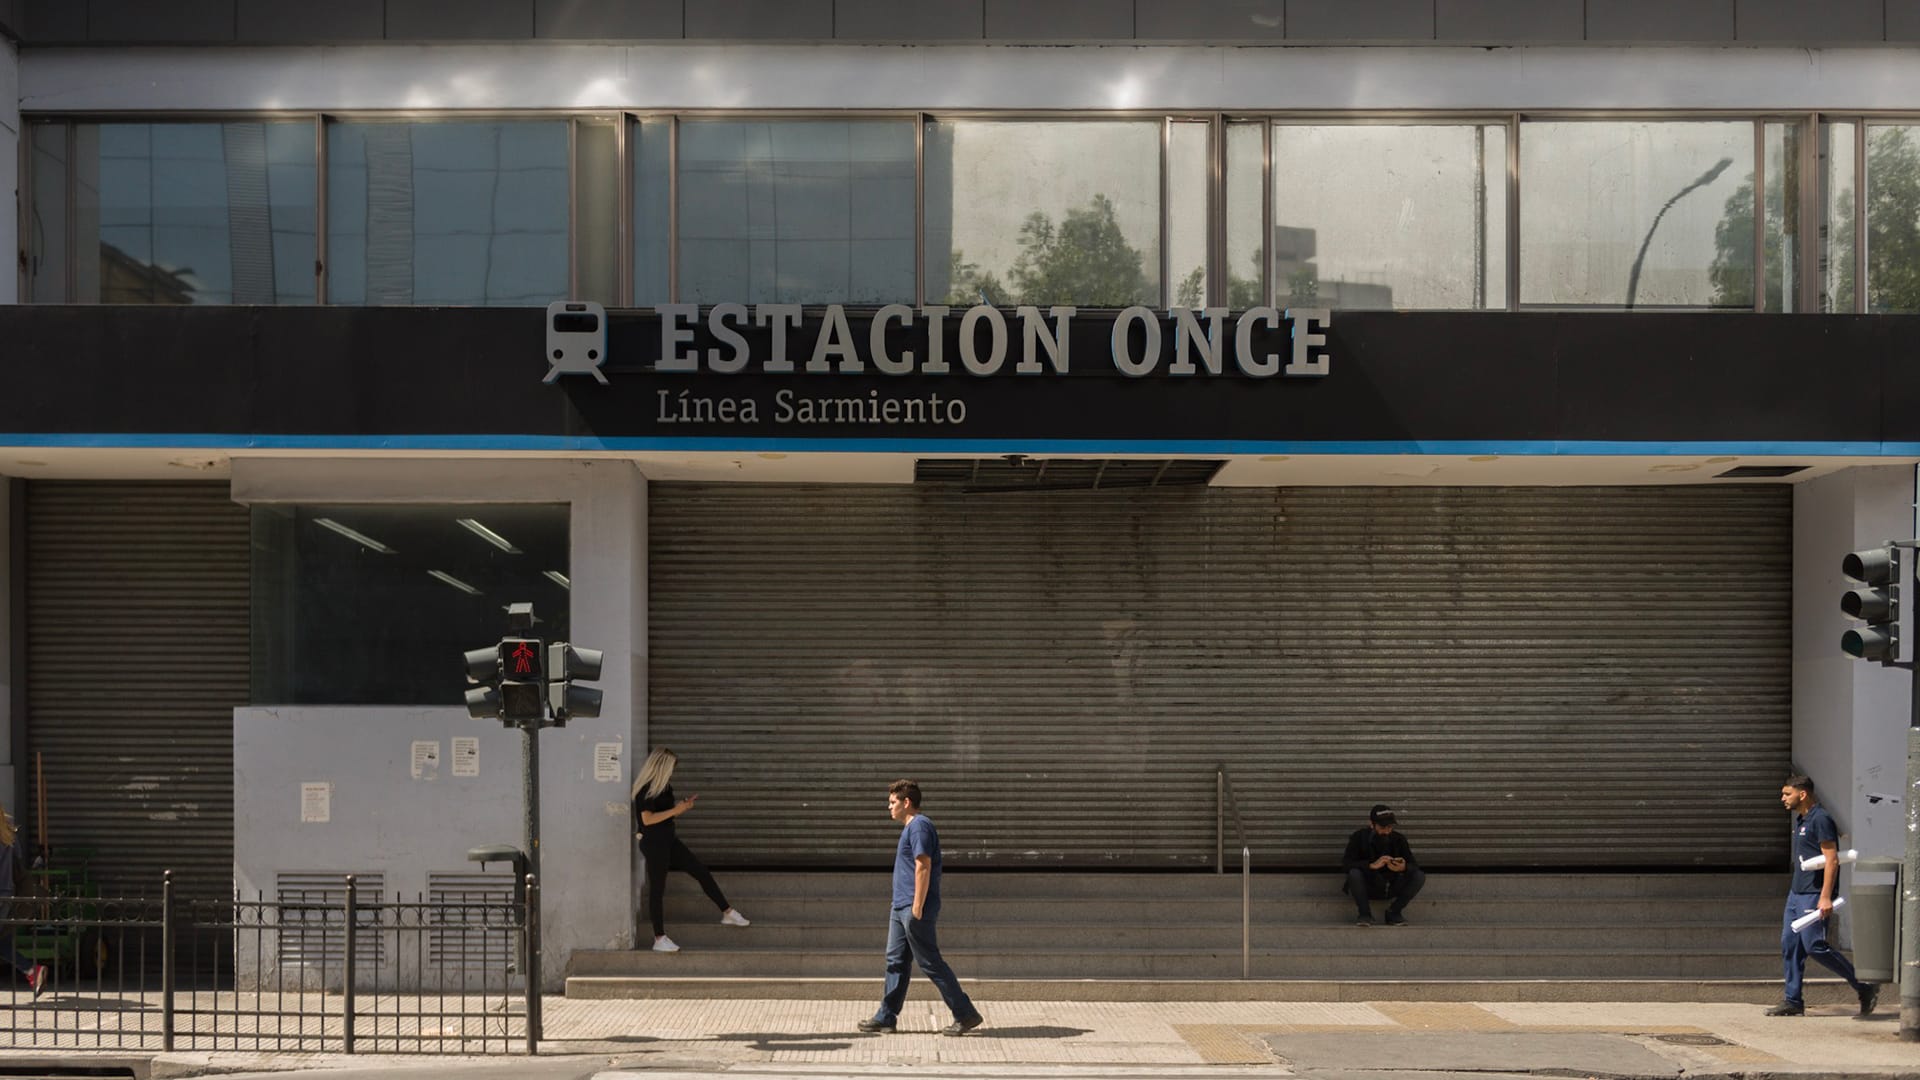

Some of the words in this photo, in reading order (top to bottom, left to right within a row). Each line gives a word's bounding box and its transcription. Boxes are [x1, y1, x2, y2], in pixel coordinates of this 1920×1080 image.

[1112, 305, 1331, 377] ONCE
[657, 389, 759, 423] Línea
[775, 389, 967, 424] Sarmiento
